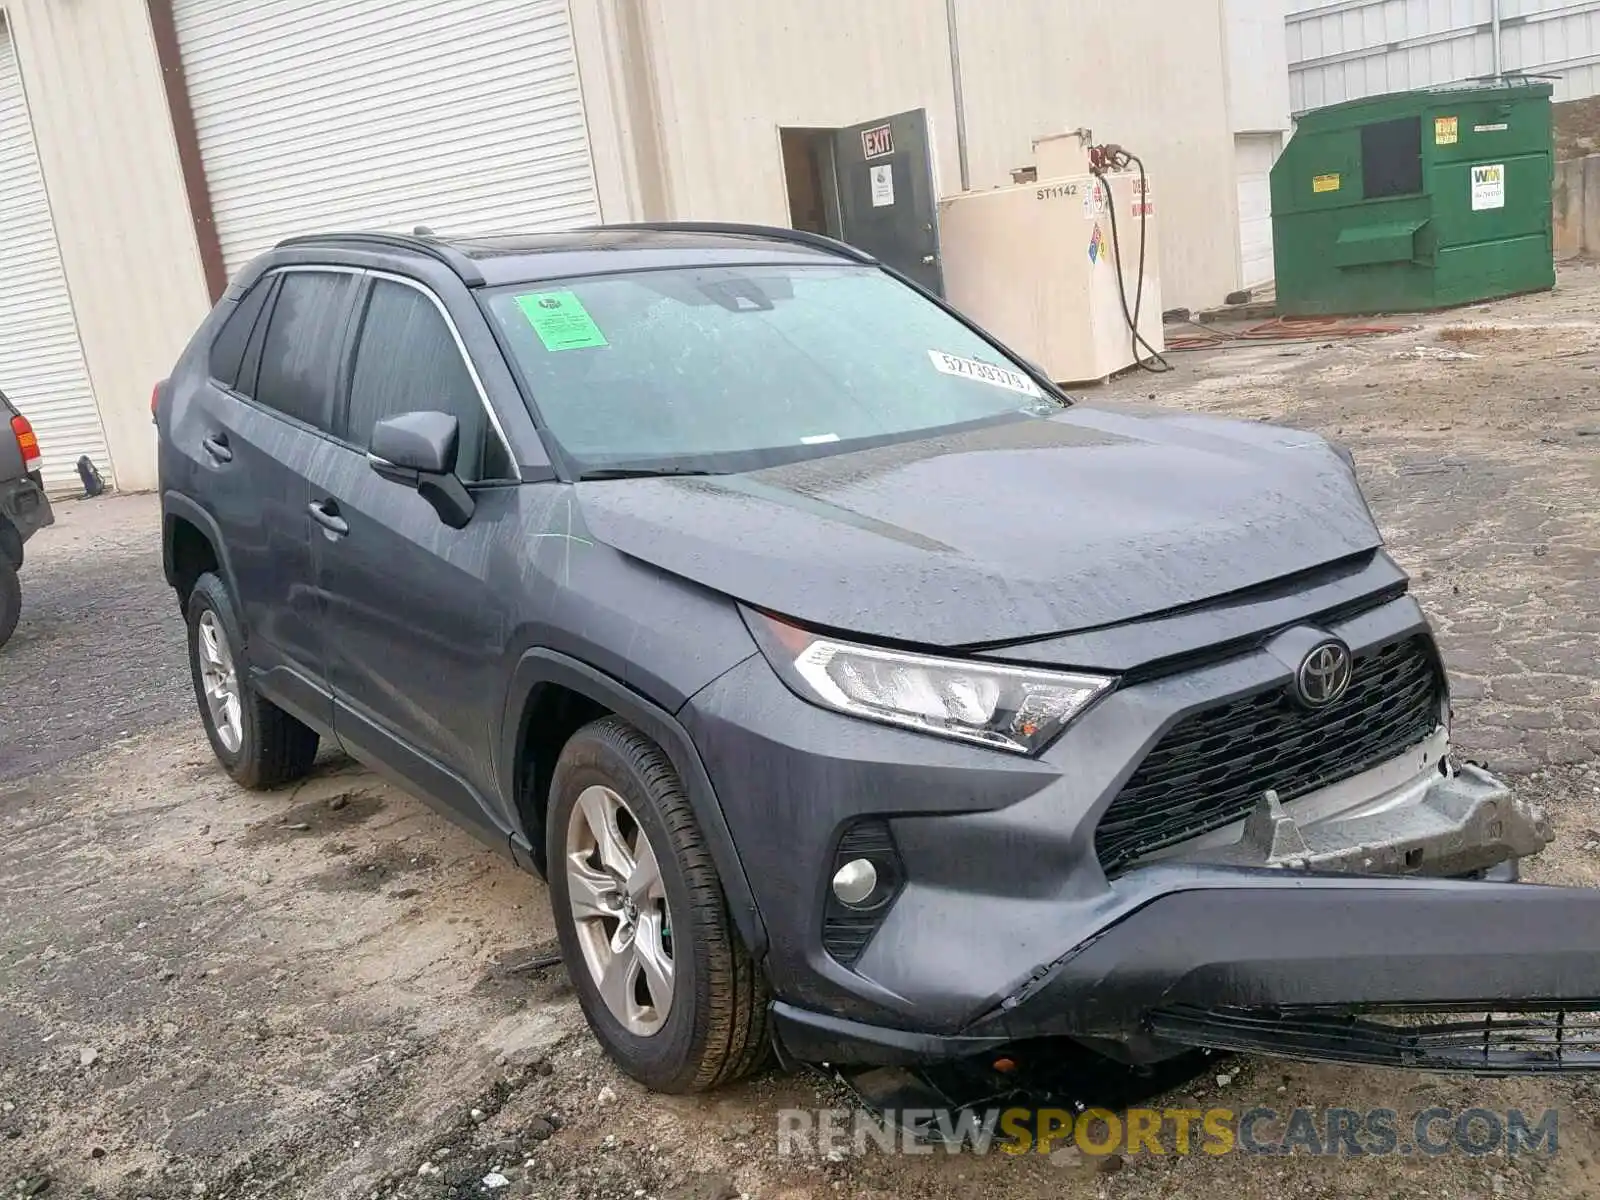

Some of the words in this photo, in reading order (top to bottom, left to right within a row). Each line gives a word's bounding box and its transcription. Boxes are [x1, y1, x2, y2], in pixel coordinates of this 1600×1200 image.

[865, 129, 890, 156] EXIT
[1037, 184, 1078, 200] ST1142
[942, 355, 1024, 389] 52739379
